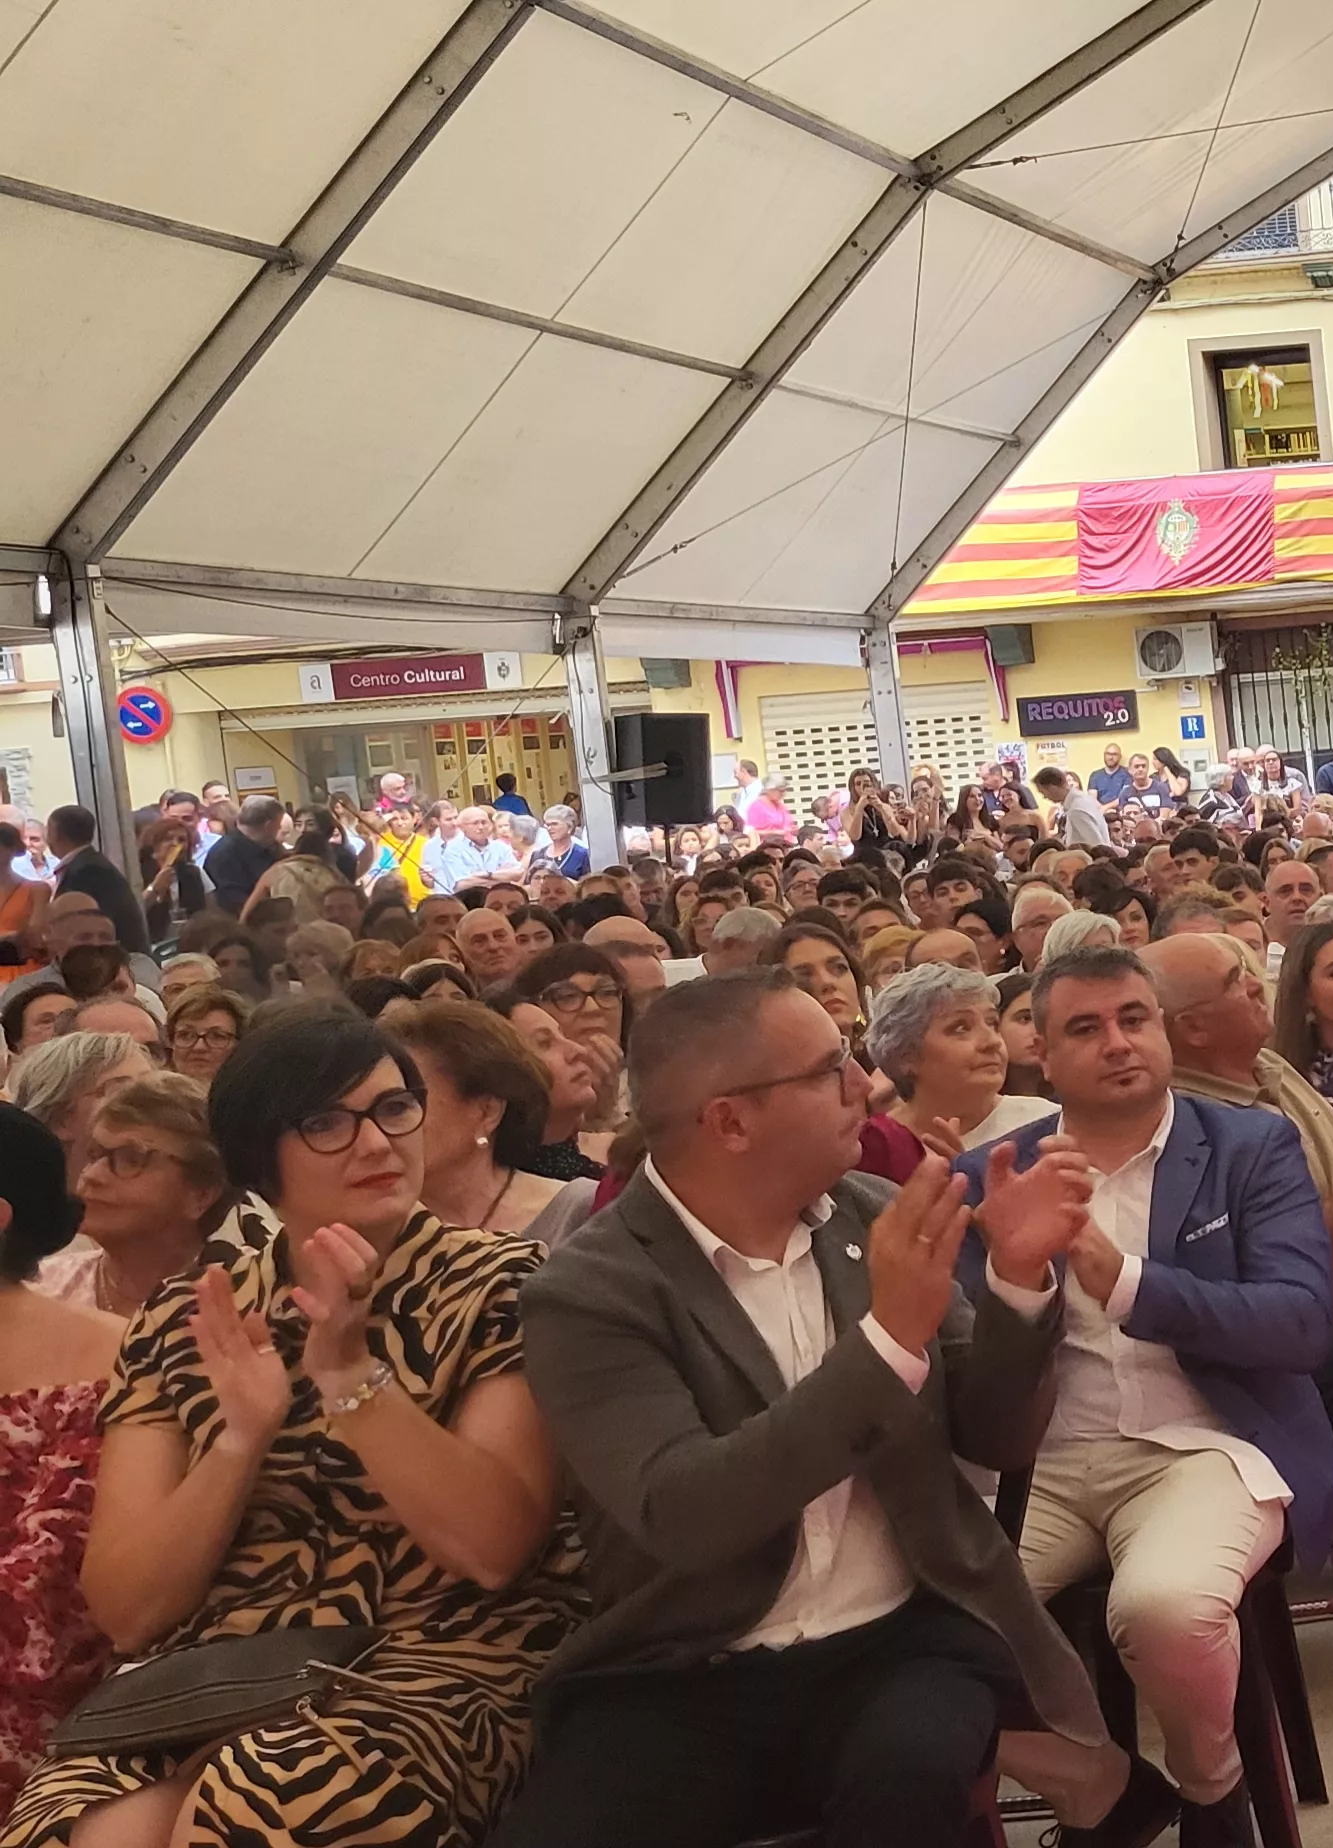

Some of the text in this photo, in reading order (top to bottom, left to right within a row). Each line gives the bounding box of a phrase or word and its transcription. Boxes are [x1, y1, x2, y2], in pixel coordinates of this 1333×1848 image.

[350, 666, 465, 688] Centro Cultural
[1027, 695, 1126, 721] REQUITOS
[1103, 708, 1130, 727] 2.0
[1186, 717, 1199, 732] R
